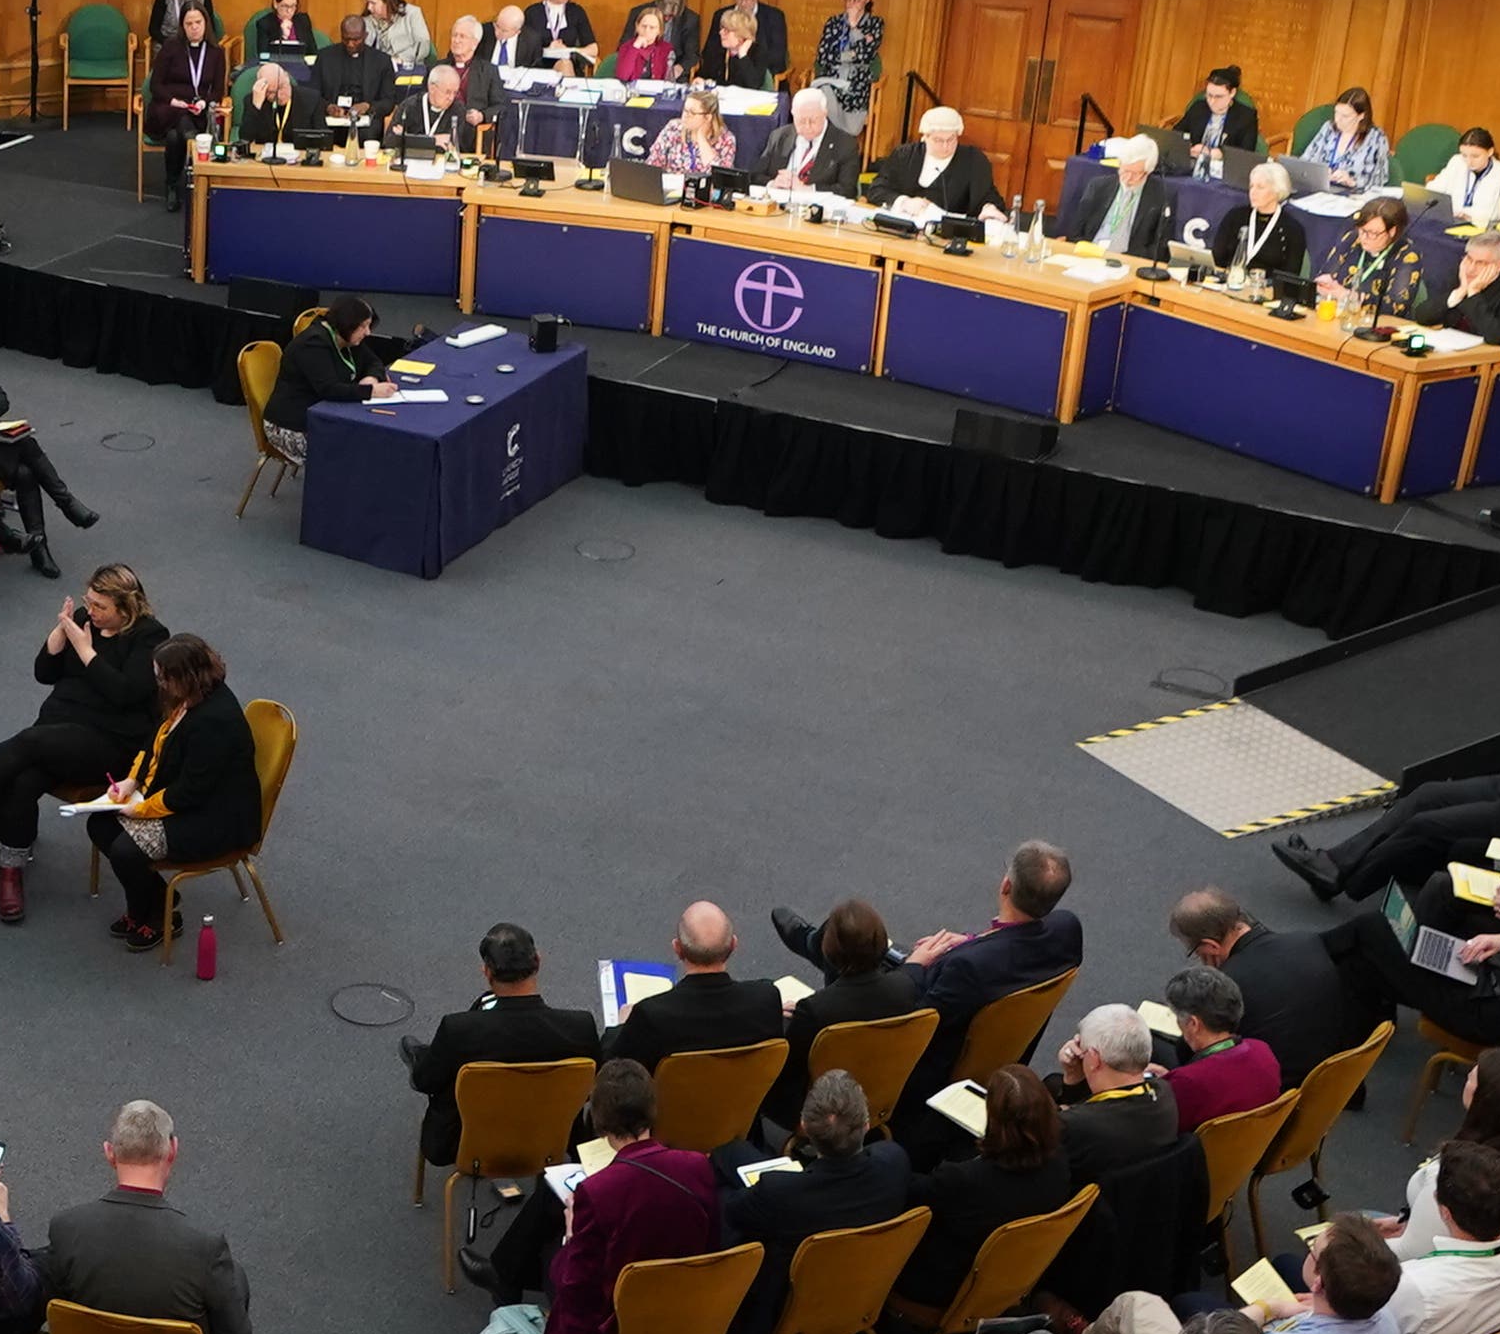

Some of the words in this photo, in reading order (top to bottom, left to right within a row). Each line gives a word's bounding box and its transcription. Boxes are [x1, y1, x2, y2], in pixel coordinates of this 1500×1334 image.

[696, 322, 718, 337] THE
[718, 327, 765, 347] CHURCH
[765, 335, 781, 349] OF
[782, 339, 836, 360] ENGLAND
